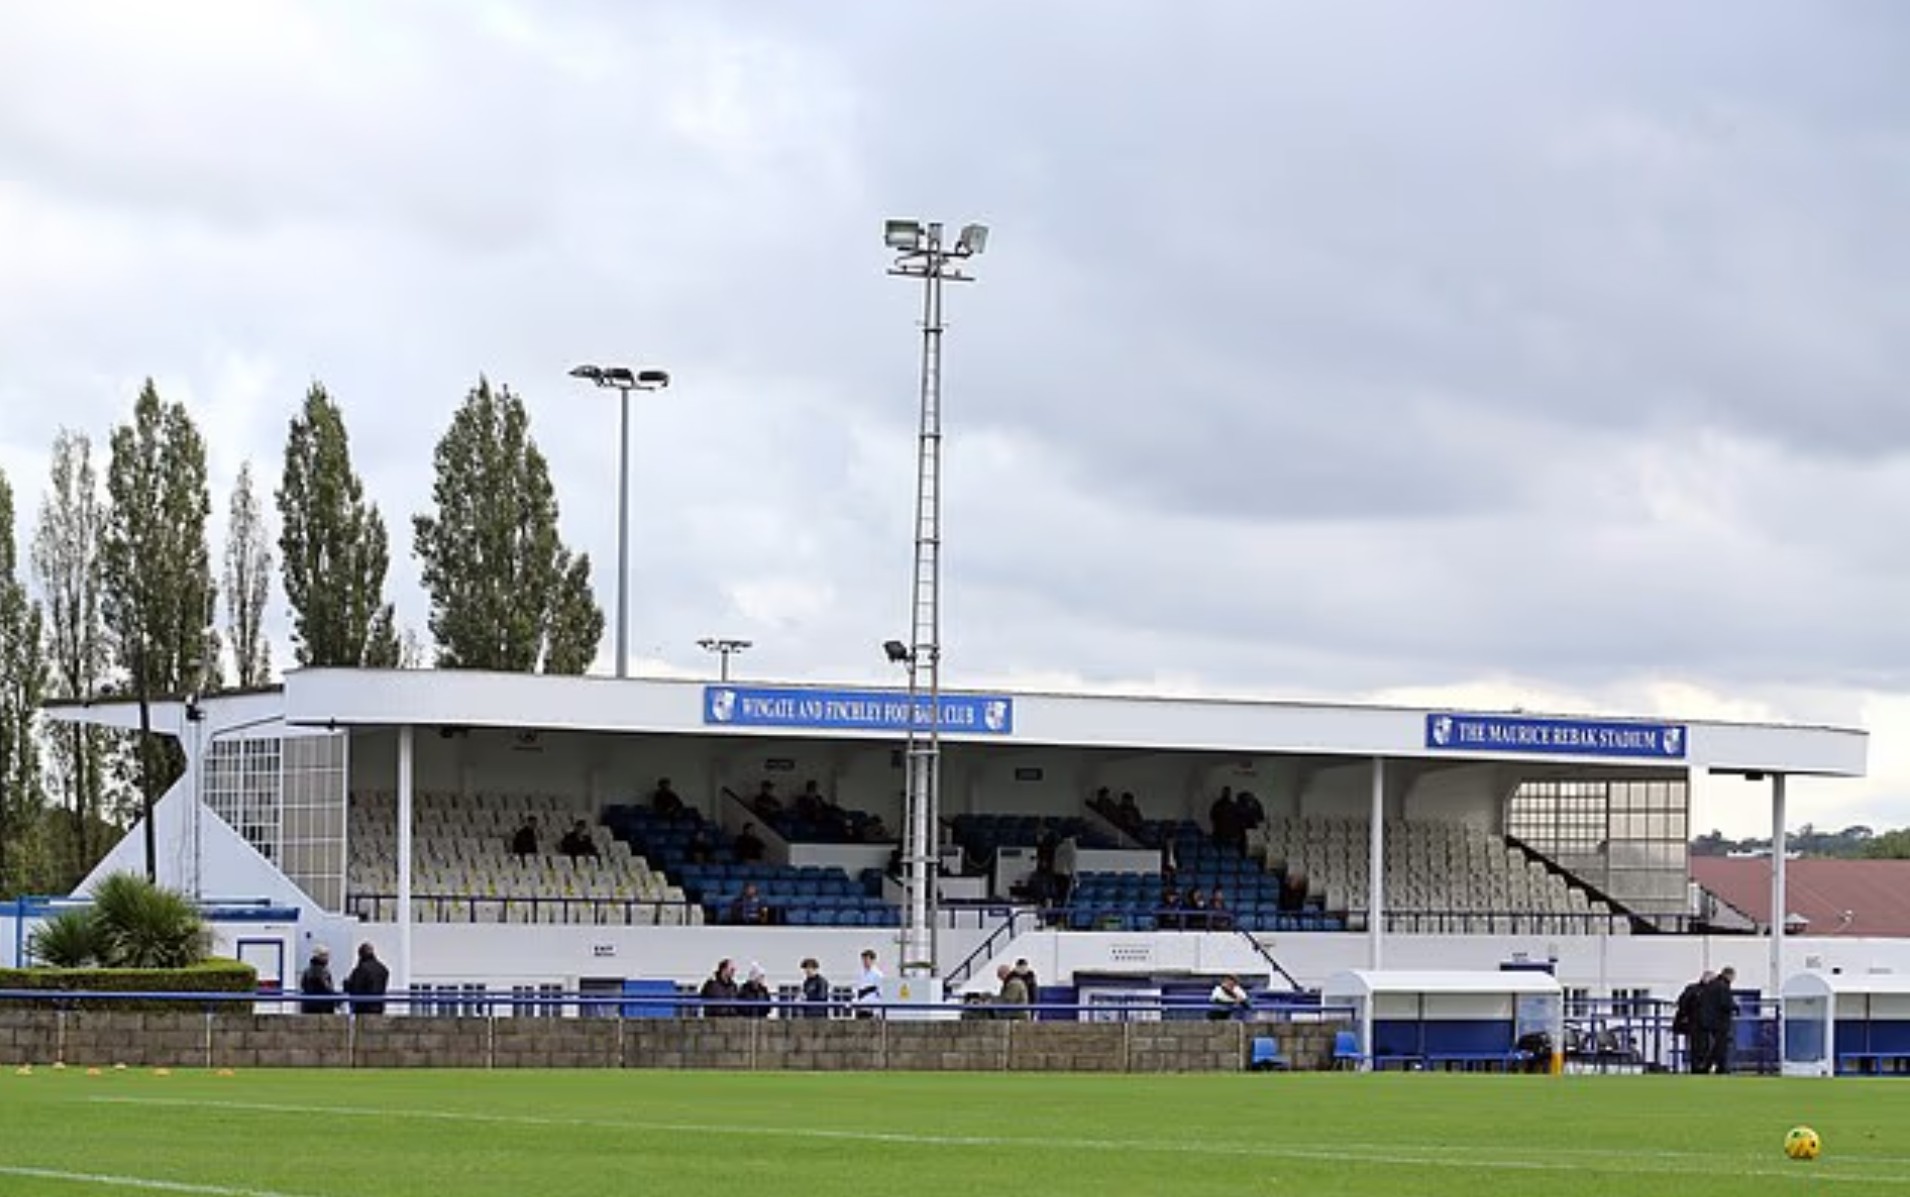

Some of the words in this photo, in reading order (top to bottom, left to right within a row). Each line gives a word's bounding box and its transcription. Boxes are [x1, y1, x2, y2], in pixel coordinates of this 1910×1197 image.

[742, 698, 796, 717] WINGATE
[800, 700, 822, 718] AND
[824, 701, 880, 720] FINCHLEY
[945, 704, 974, 724] CLUB
[1459, 722, 1486, 741] THE
[1488, 725, 1550, 744] MAURICE
[1553, 728, 1597, 746] REBAK
[1600, 730, 1656, 748] STADIUM
